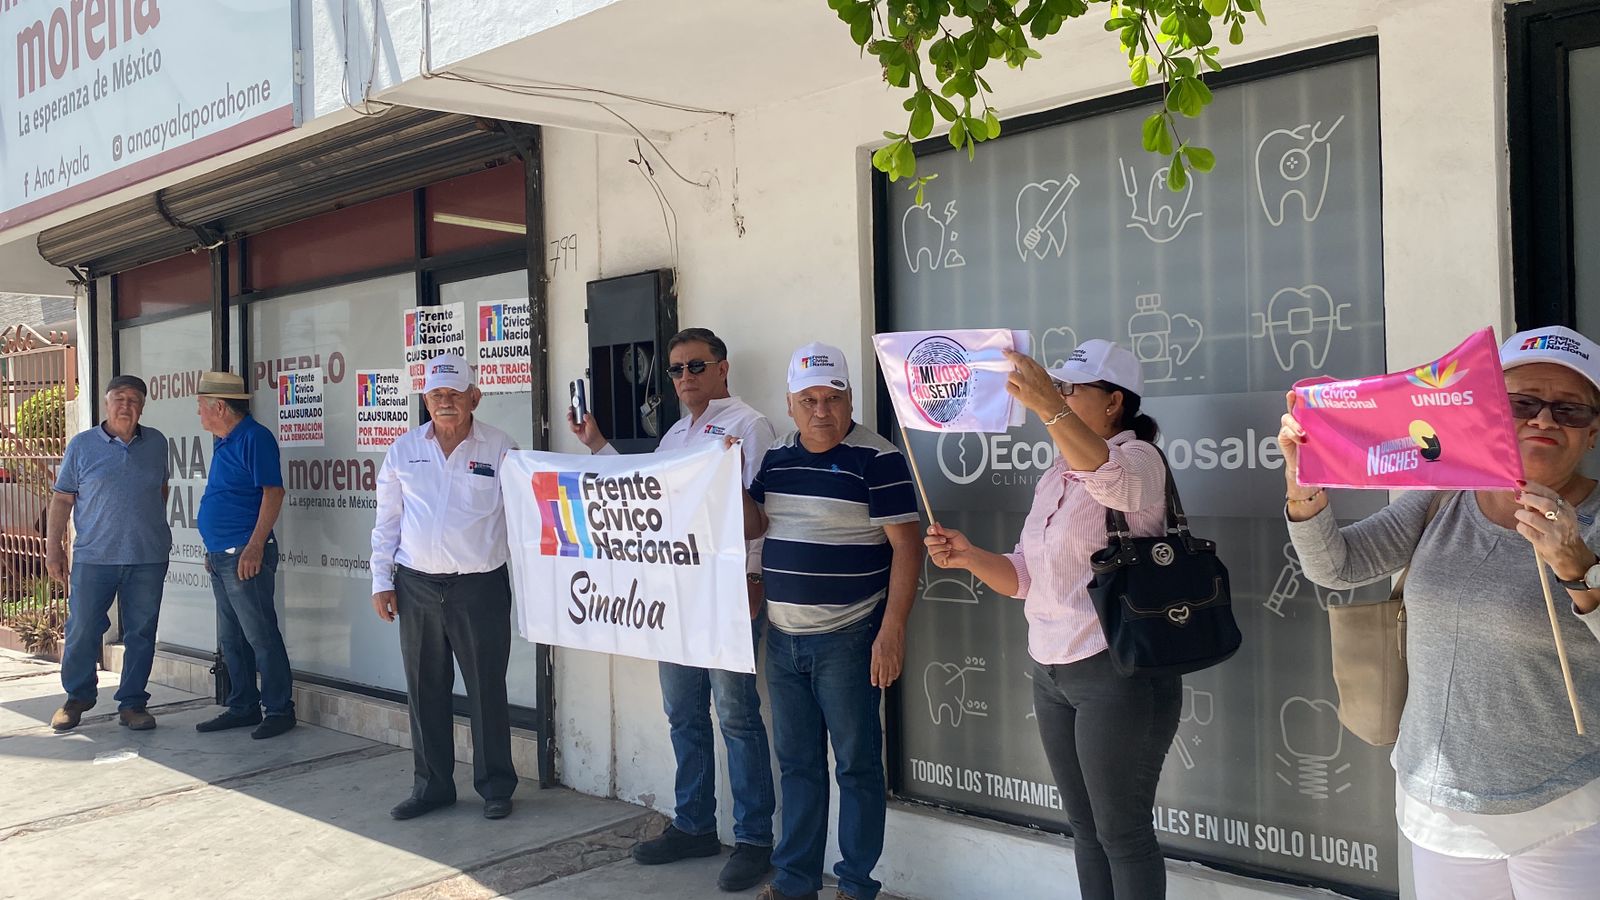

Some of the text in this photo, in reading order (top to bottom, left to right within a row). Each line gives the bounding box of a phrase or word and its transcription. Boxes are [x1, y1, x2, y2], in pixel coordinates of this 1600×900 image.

[17, 0, 160, 99] morena
[19, 48, 161, 137] La esperanza de México
[34, 165, 54, 191] Ana
[58, 146, 90, 187] Ayala
[127, 79, 271, 152] anaayalaporahome
[550, 233, 578, 277] 799
[419, 308, 453, 322] Frente
[419, 322, 453, 334] Cívico
[503, 328, 531, 341] Nacio
[419, 330, 464, 345] Nacional
[1548, 334, 1581, 346] Frente
[480, 345, 530, 358] CLAUSURA
[1546, 344, 1590, 360] Nacional
[481, 364, 498, 374] POR
[295, 373, 315, 383] Frente
[376, 373, 399, 384] Frente
[486, 377, 495, 385] LA
[497, 375, 532, 384] DEMOCRA
[295, 393, 322, 405] Nacional
[376, 396, 408, 407] Nacional
[1323, 398, 1377, 409] Nacional
[1411, 390, 1474, 408] UNID@S
[280, 407, 322, 420] CLAUSURADO
[358, 411, 408, 422] CLAUSURADO
[281, 424, 293, 433] POR
[359, 427, 372, 436] POR
[291, 432, 323, 441] DEMOCRACIA
[362, 438, 371, 446] LA
[991, 428, 1285, 470] Eco osale
[169, 436, 207, 480] NA
[1367, 444, 1419, 477] NOCHES
[288, 458, 377, 491] morena
[583, 471, 661, 501] Frente
[289, 495, 377, 510] La esperanza de México
[588, 501, 663, 532] Cívico
[183, 544, 206, 558] FEDERA
[592, 532, 700, 565] Nacional
[278, 550, 370, 573] na Ayala anaayalap
[568, 570, 666, 630] Sinaloa
[910, 758, 953, 787] TODOS
[957, 767, 982, 793] LOS
[985, 773, 1063, 810] TRATAMIE
[1195, 813, 1218, 842] EN
[1224, 818, 1250, 848] UN
[1254, 824, 1304, 858] SOLO
[1310, 833, 1379, 873] LUGAR
